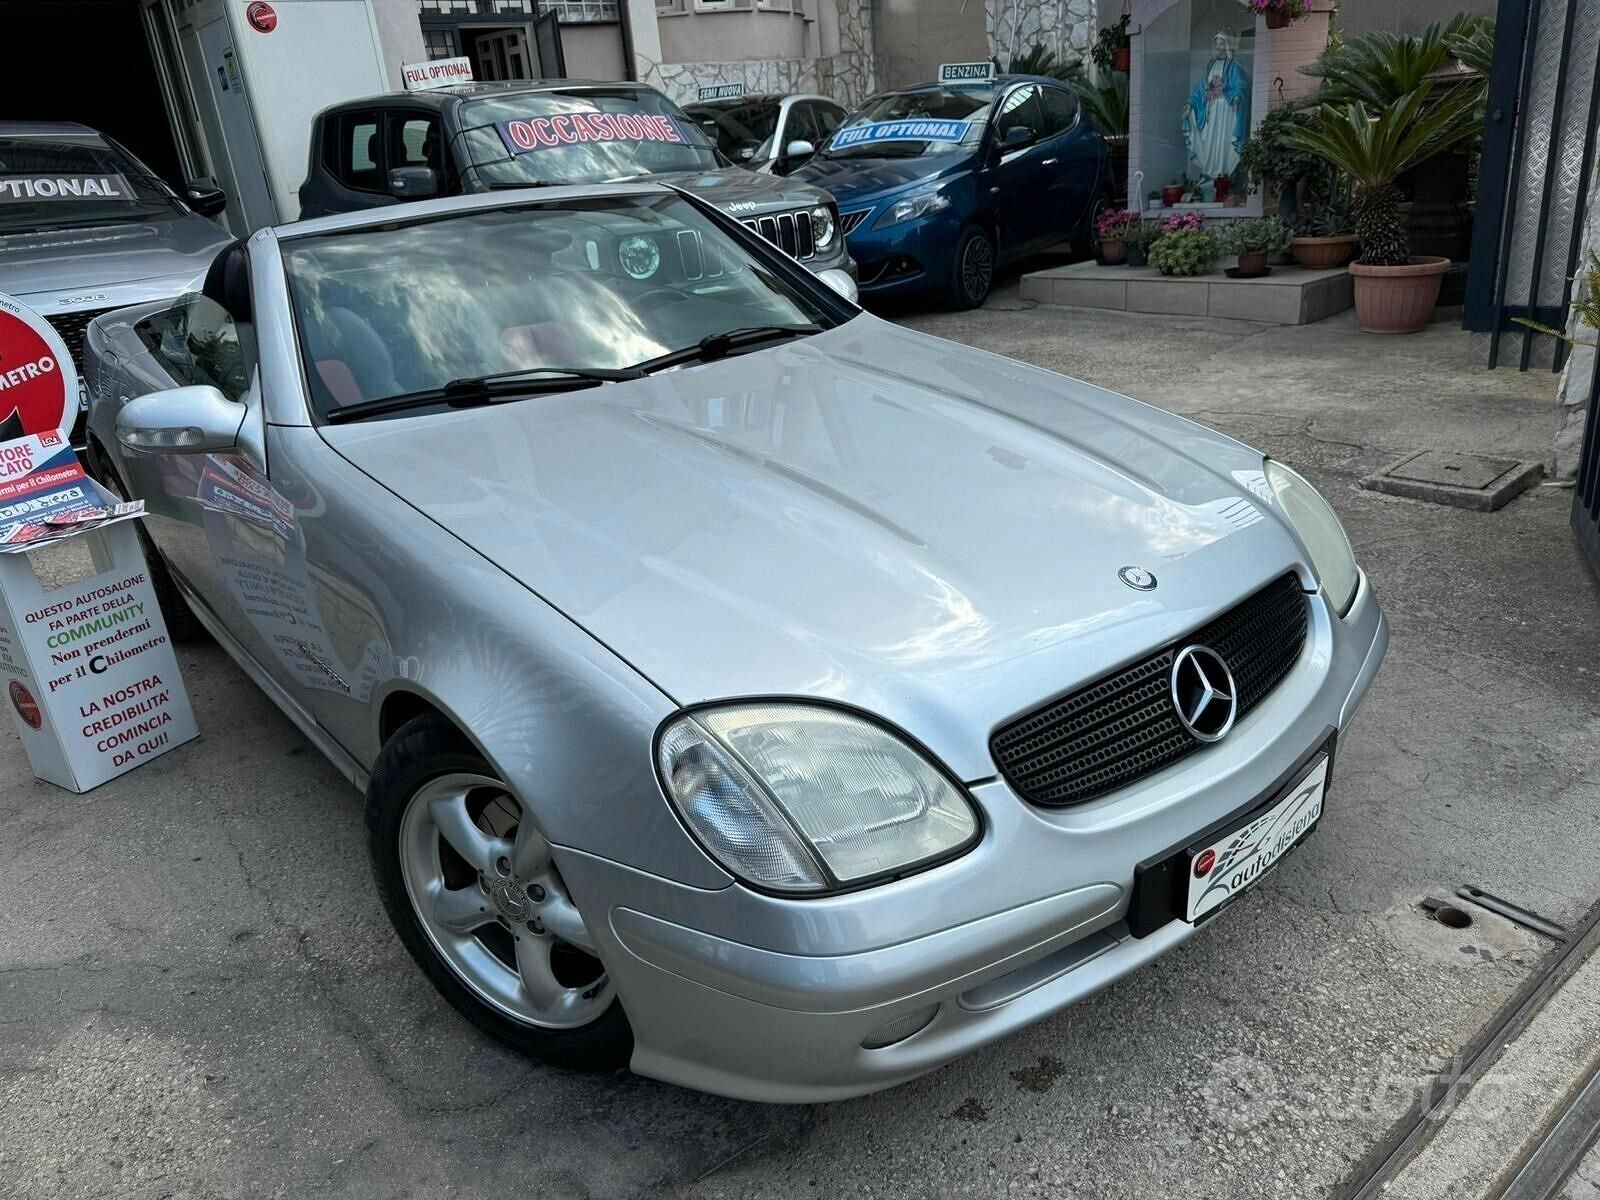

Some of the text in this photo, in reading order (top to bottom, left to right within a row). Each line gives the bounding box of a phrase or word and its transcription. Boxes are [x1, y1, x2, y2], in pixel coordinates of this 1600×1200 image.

[406, 63, 471, 83] FULL OPTIONAL
[699, 84, 741, 99] SEMI NUOVA
[944, 65, 987, 79] BENZINA
[509, 113, 681, 150] OCCASIONE
[839, 123, 958, 145] FULL OPTIONAL
[728, 201, 757, 211] Jeep
[16, 482, 29, 492] per
[35, 468, 78, 486] Chilometro
[24, 573, 146, 624] QUESTO AUTOSALONE
[48, 593, 135, 632] FA PARTE DELLA
[46, 602, 145, 649] COMMUNITY
[51, 618, 152, 666] Non prendermi
[47, 634, 167, 693] per il Chilometro
[79, 674, 162, 718] LA NOSTRA
[82, 689, 170, 738] CREDIBILITA'
[96, 712, 172, 753] COMINCIA
[112, 732, 169, 768] DA QUI!
[1230, 800, 1321, 890] autodisiena
